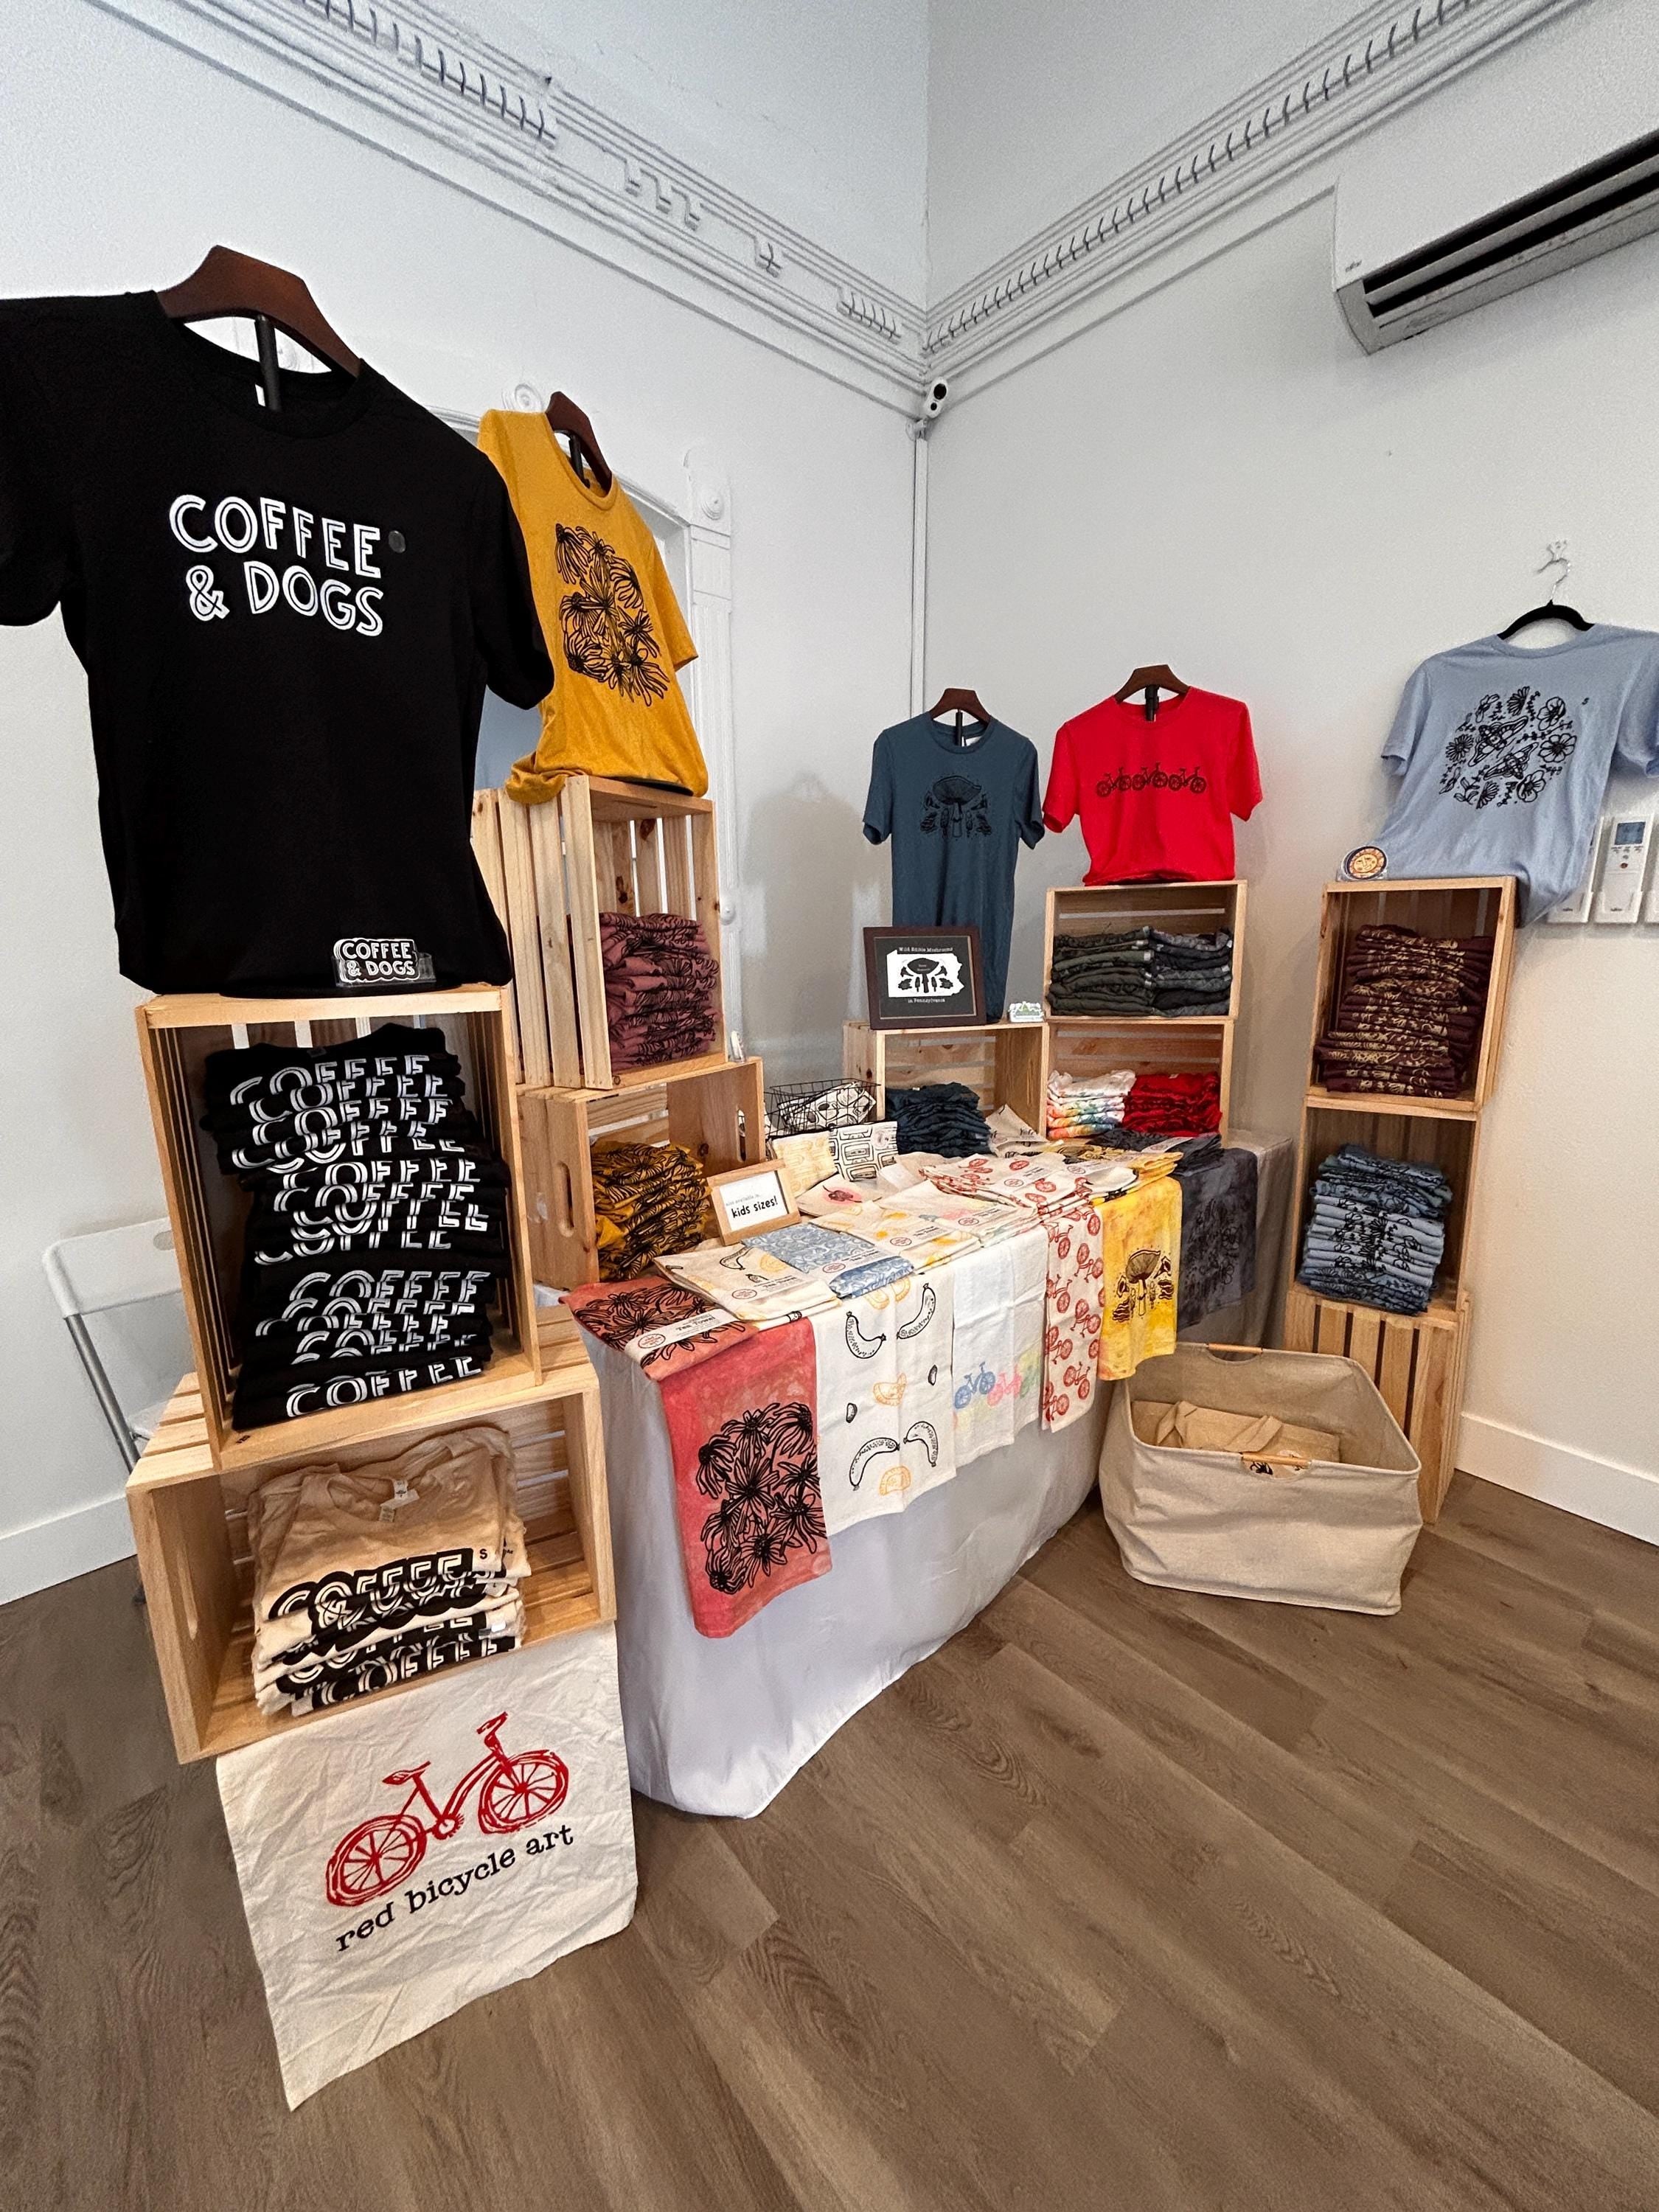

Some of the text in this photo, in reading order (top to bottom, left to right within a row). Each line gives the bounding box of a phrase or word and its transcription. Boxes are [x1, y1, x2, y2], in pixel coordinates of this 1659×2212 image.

[169, 494, 381, 578] COFFEE
[186, 560, 384, 636] & DOGS
[342, 942, 412, 959] COFFEE
[347, 960, 415, 977] & DOGS
[248, 1074, 448, 1123] COFFEE
[731, 1195, 778, 1218] kids sizes!
[479, 1548, 488, 1559] S
[335, 1825, 574, 1952] red bicycle art
